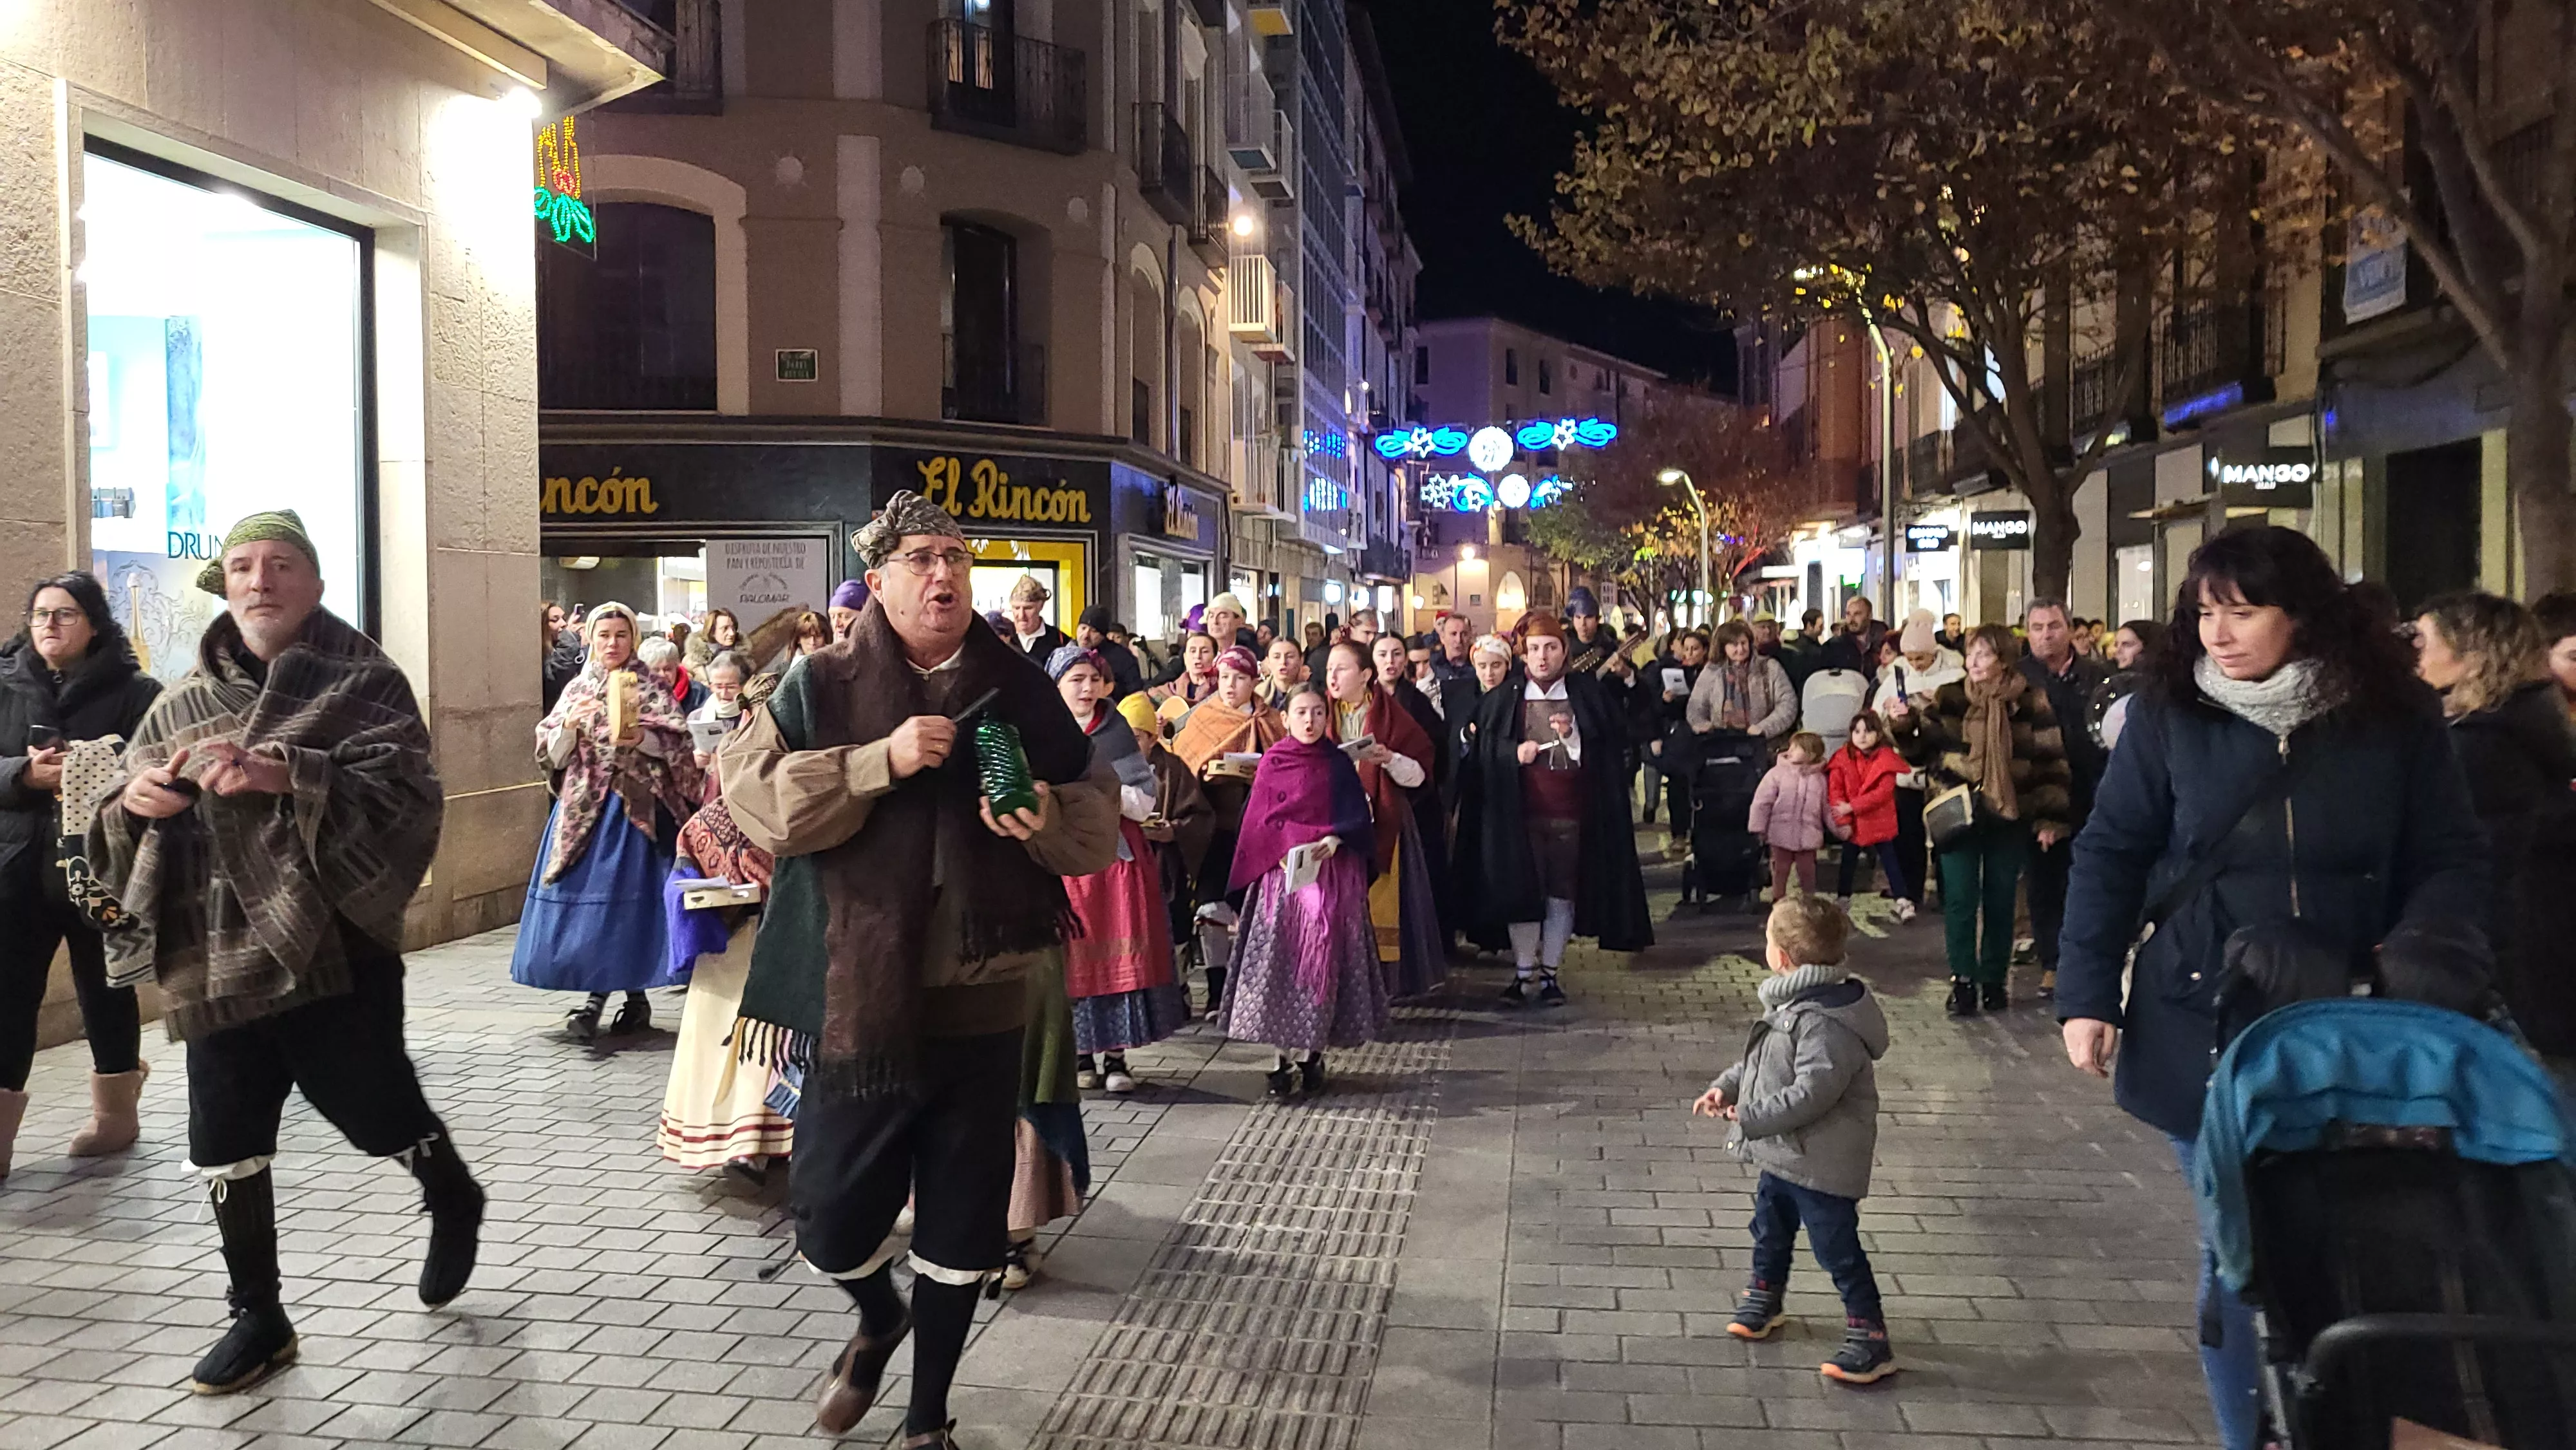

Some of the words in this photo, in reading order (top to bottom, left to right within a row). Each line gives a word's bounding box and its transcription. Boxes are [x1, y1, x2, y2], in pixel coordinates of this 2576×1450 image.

[2223, 464, 2310, 483] MANGO
[540, 466, 659, 514] ncón
[917, 456, 962, 516] El
[968, 458, 1091, 523] Rincón
[1973, 520, 2027, 535] MANGO
[724, 542, 761, 554] DISFRUTA
[762, 542, 771, 554] DE
[773, 541, 806, 554] NUESTRO
[726, 558, 743, 569] PAN
